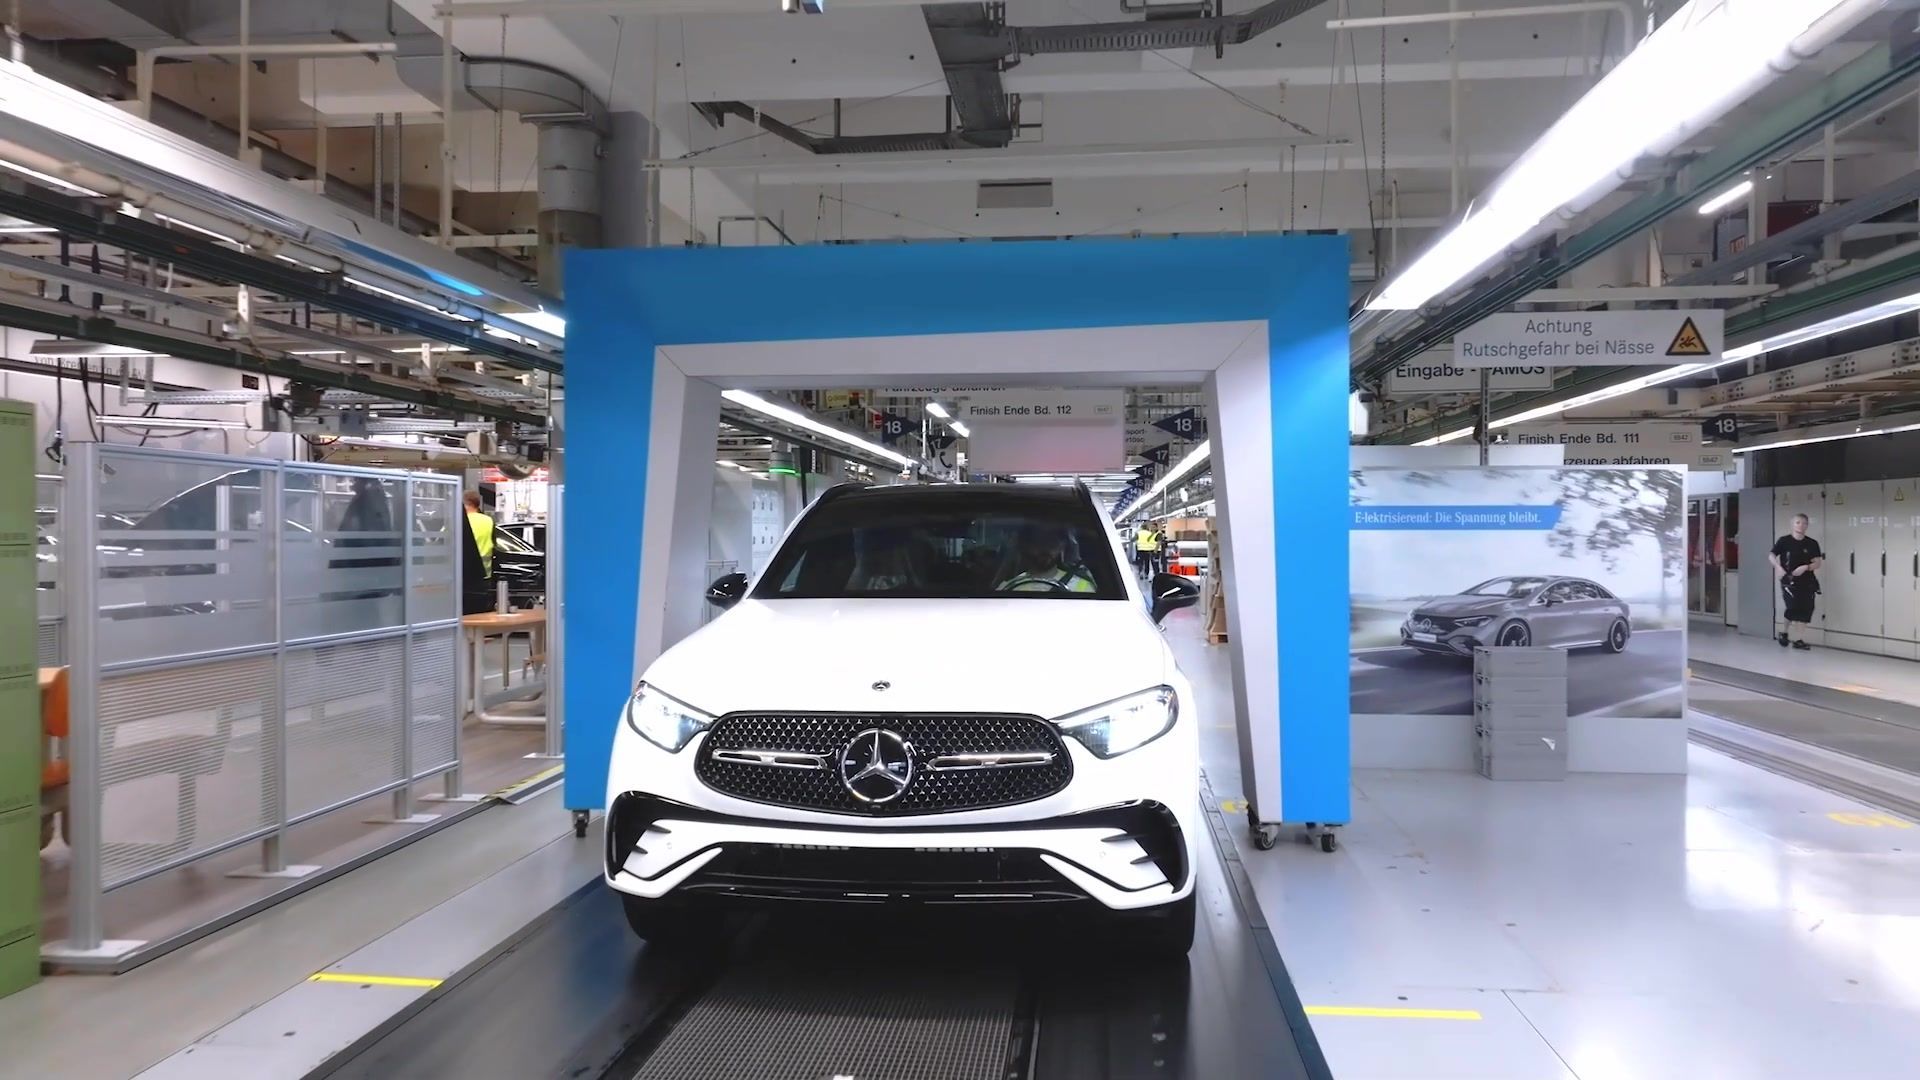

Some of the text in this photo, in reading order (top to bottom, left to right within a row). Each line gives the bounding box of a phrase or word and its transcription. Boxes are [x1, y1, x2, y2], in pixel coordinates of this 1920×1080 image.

[1525, 319, 1592, 336] Achtung
[1463, 340, 1654, 359] Rutschgefahr bei Nässe
[1396, 363, 1464, 380] Eingabe
[970, 405, 1072, 416] Finish Ende Bd. 112
[885, 420, 902, 434] 18
[1174, 418, 1192, 432] 18
[1715, 418, 1735, 433] 18
[1518, 433, 1640, 444] Finish Ende Bd. 111
[1156, 449, 1168, 460] 17
[1355, 511, 1541, 526] E-lektrisierend: Die Spannung bleibt.
